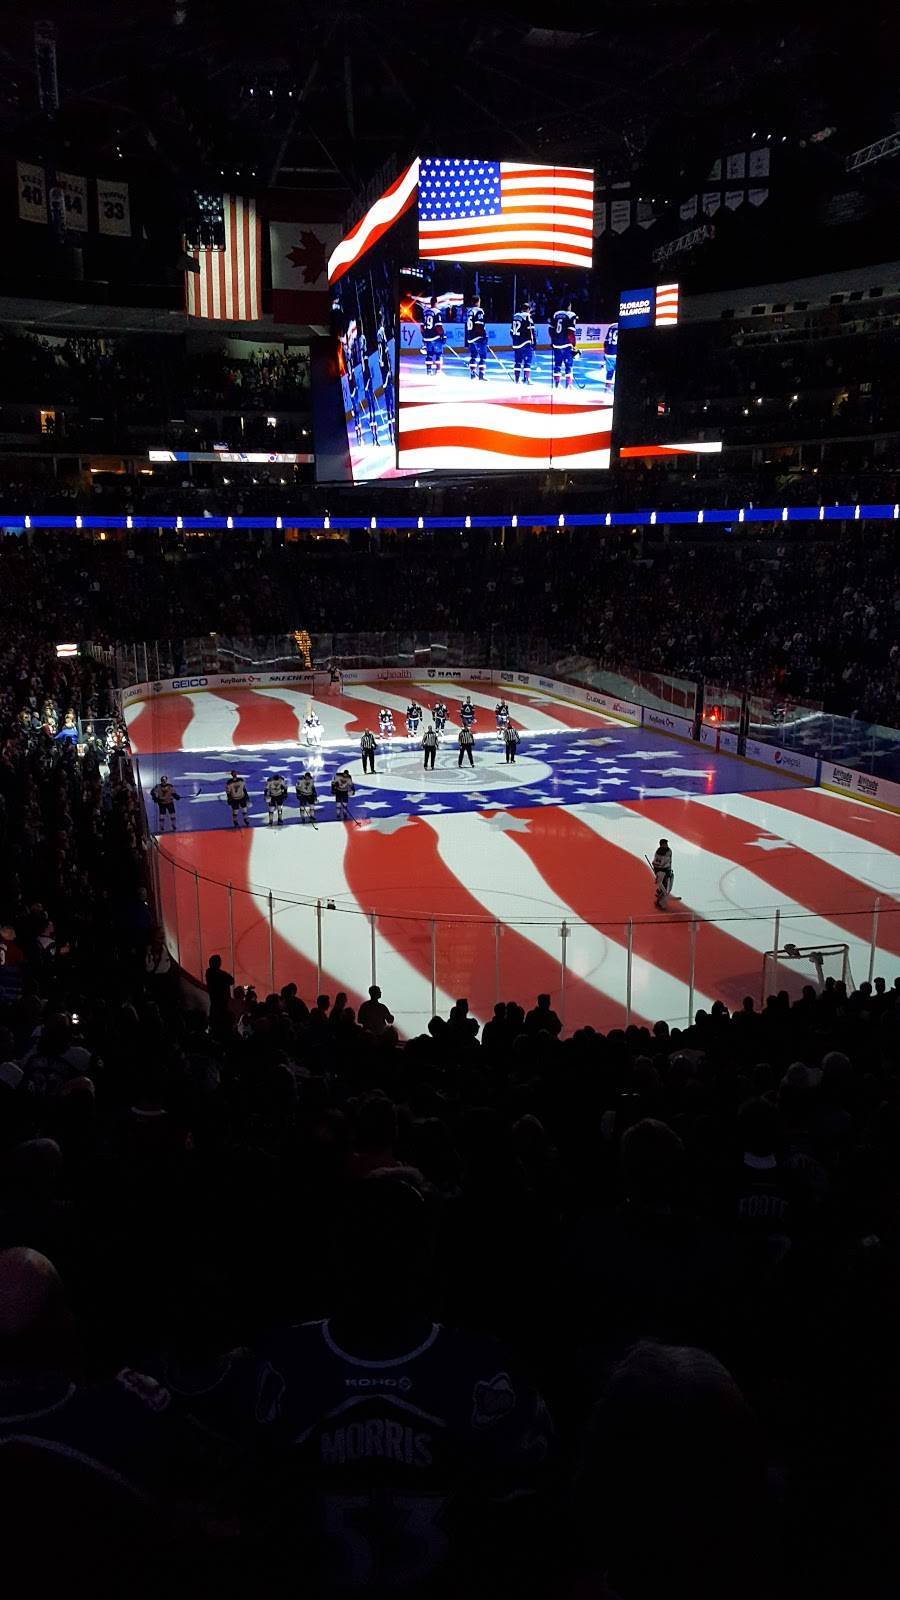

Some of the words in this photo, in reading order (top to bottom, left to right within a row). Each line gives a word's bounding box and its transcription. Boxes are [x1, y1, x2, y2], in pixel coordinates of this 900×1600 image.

[104, 201, 125, 220] 33
[619, 299, 650, 310] OLORADO
[438, 671, 461, 679] RAM
[172, 678, 208, 689] GEICO
[783, 757, 801, 769] pepsi
[344, 1378, 398, 1388] KOHO
[320, 1418, 433, 1469] MORRIS
